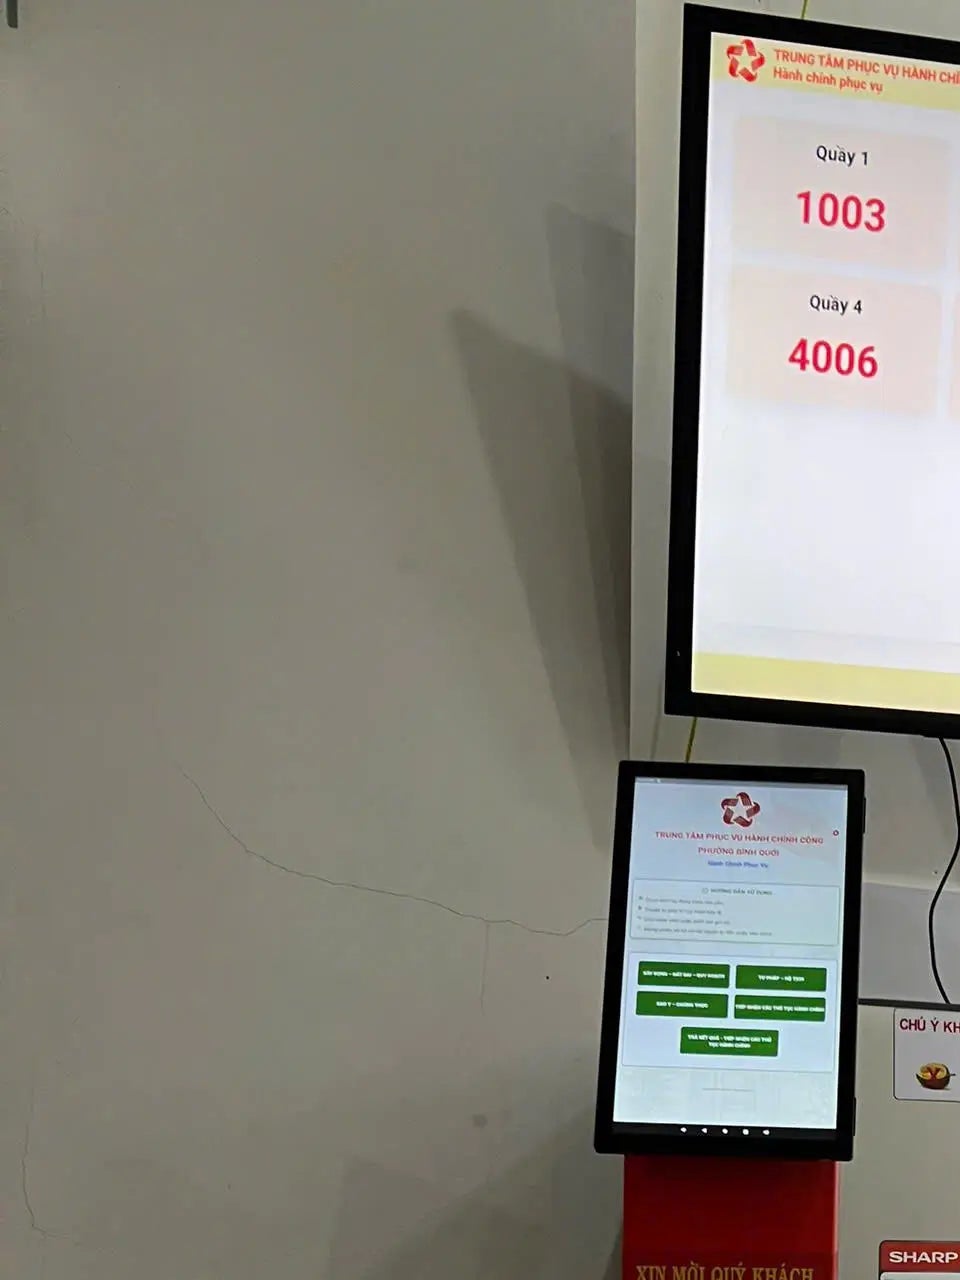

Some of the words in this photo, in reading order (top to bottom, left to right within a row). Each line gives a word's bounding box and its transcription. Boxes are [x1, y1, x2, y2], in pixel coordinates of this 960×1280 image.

[774, 49, 815, 65] TRUNG
[818, 54, 843, 68] TÂM
[847, 59, 880, 75] PHỤC
[884, 64, 899, 79] VỤ
[902, 65, 936, 82] HÀNH
[773, 67, 802, 81] Hành
[806, 71, 836, 86] chính
[840, 76, 867, 92] phục
[870, 82, 883, 94] vụ
[816, 144, 856, 166] Quầy
[863, 151, 869, 165] 1
[797, 191, 886, 232] 1003
[809, 293, 850, 316] Quầy
[854, 299, 863, 314] 4
[788, 339, 878, 378] 4006
[900, 1016, 926, 1031] CHÚ
[930, 1017, 939, 1032] Ý
[889, 1251, 959, 1264] SHARP
